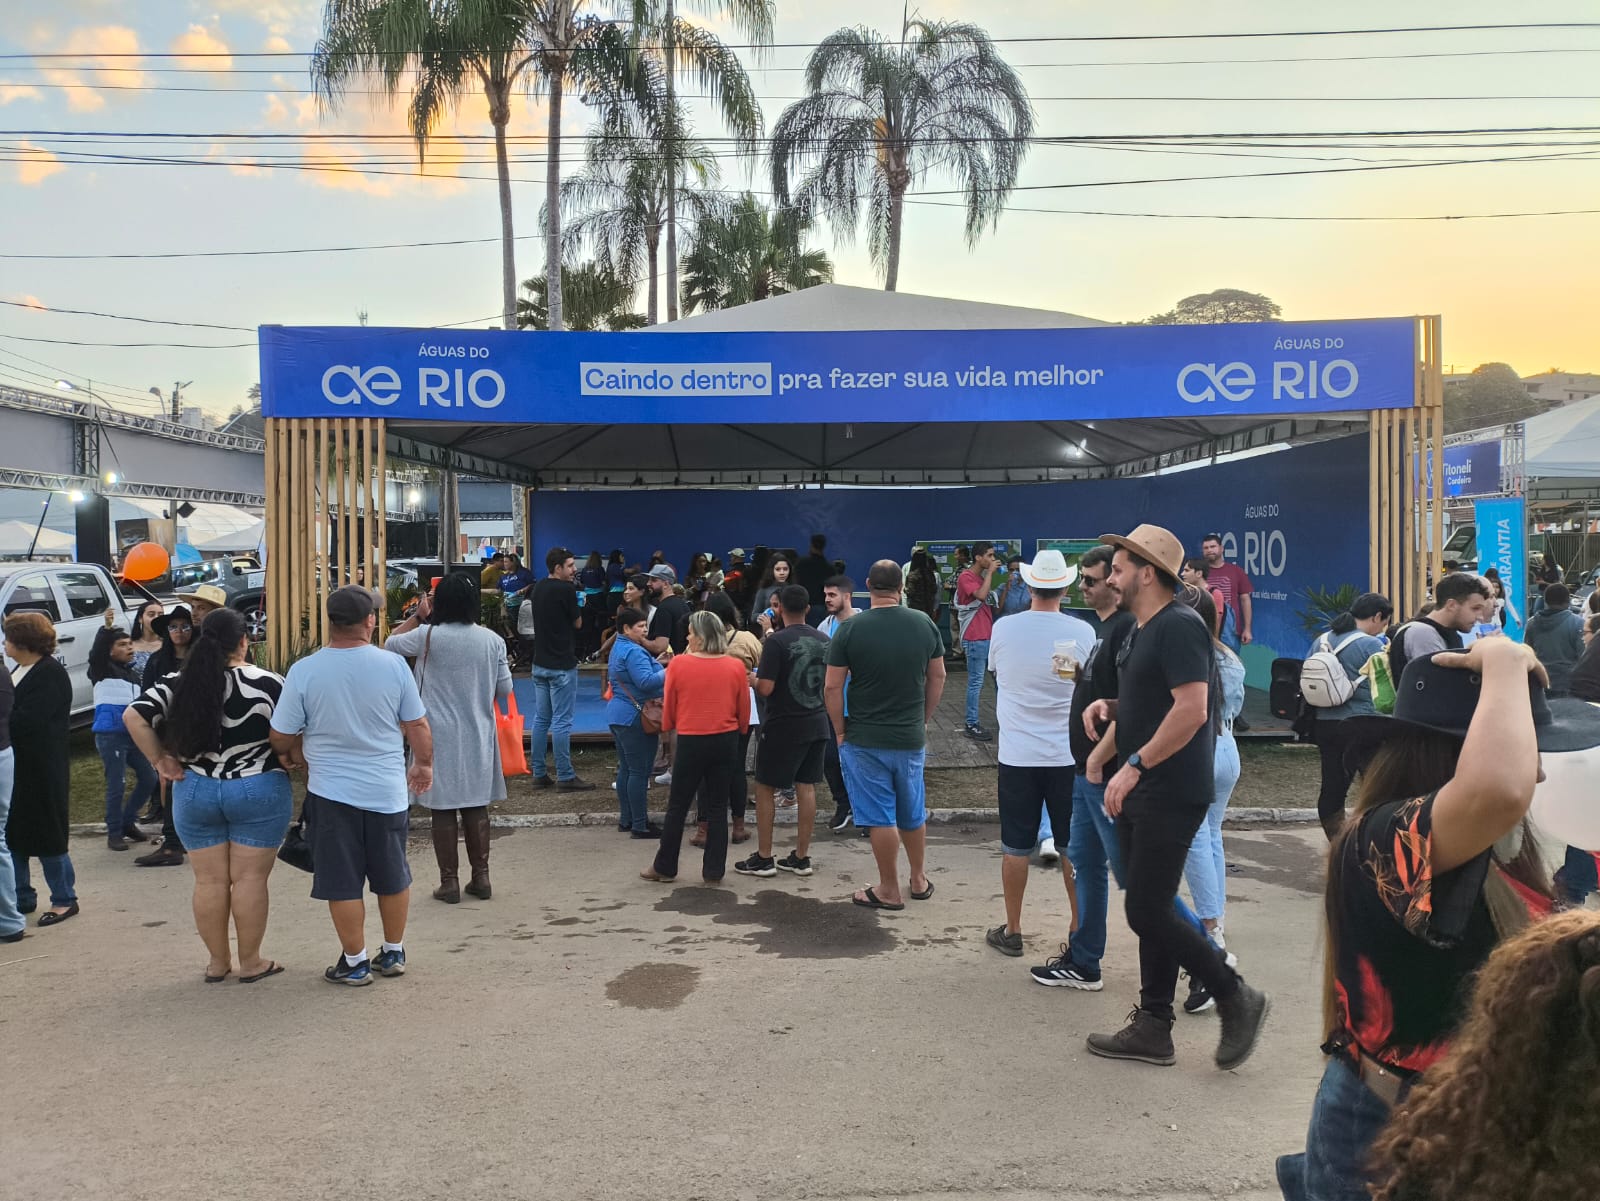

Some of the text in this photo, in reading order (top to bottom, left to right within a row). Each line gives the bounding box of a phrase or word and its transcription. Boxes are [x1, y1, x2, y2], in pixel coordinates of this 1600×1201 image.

[418, 343, 489, 358] ÁGUAS DO
[1274, 337, 1344, 351] ÁGUAS DO
[418, 367, 506, 409] RIO
[584, 364, 1104, 395] Caindo dentro pra fazer sua vida melhor
[1272, 359, 1359, 400] RIO
[1244, 503, 1279, 519] ÁGUAS DO
[1244, 529, 1287, 576] RIO
